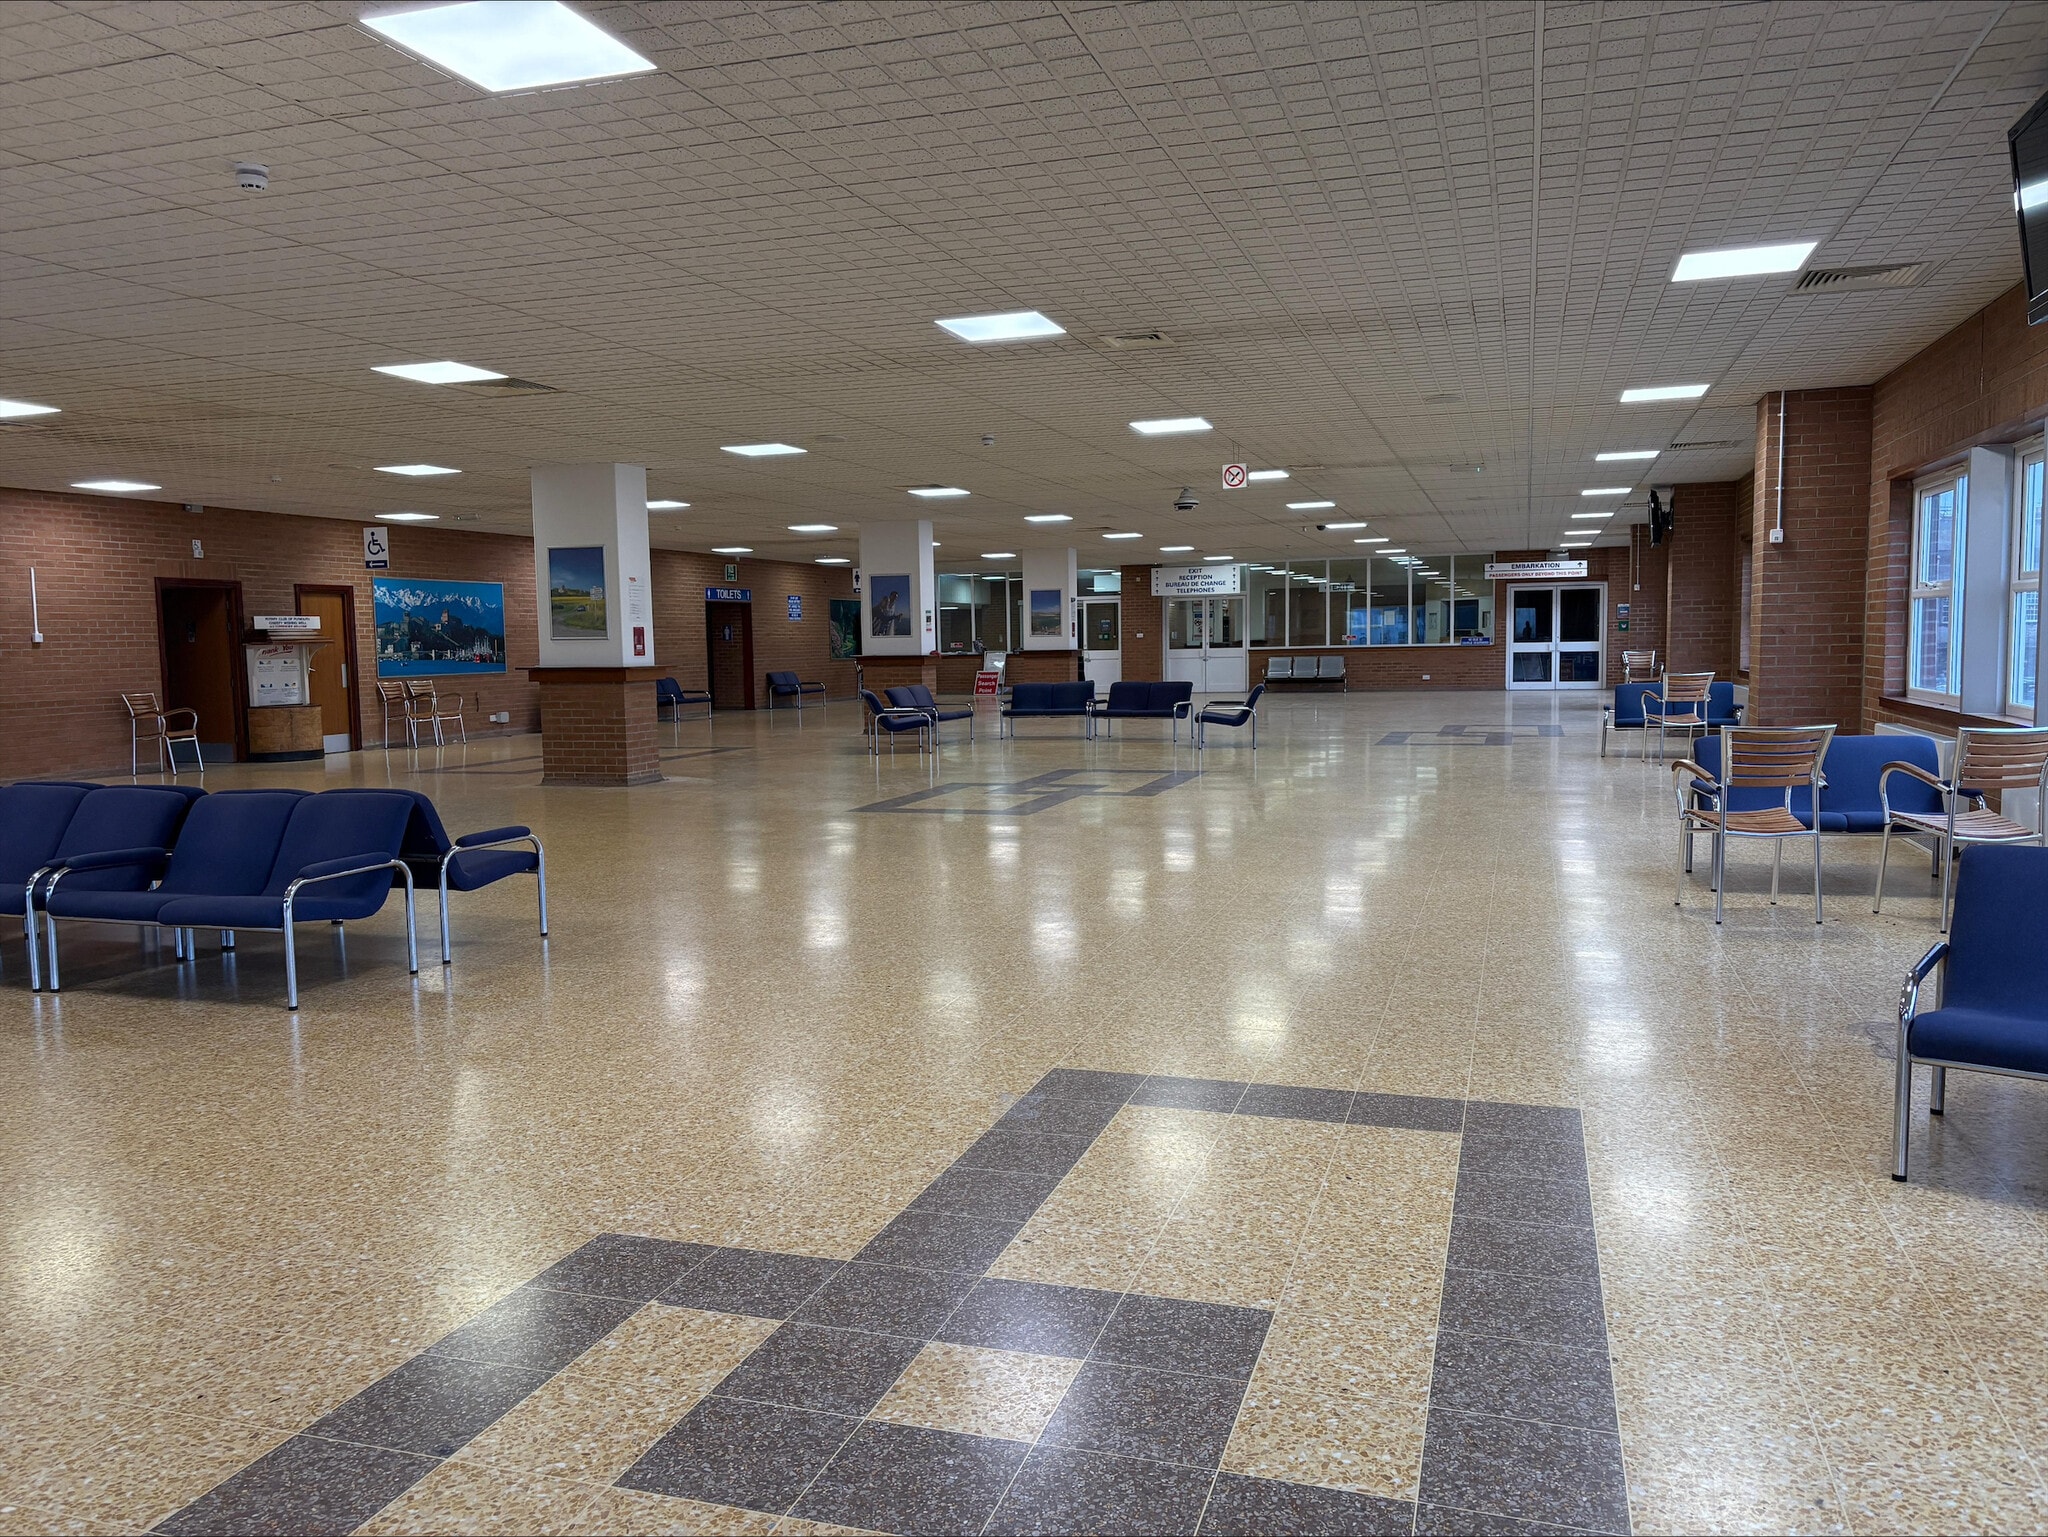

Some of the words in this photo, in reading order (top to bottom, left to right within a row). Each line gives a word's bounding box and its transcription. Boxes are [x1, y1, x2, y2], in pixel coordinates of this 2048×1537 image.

[1511, 562, 1560, 570] EMBARKATION
[716, 589, 742, 600] TOILETS
[261, 646, 279, 655] hank
